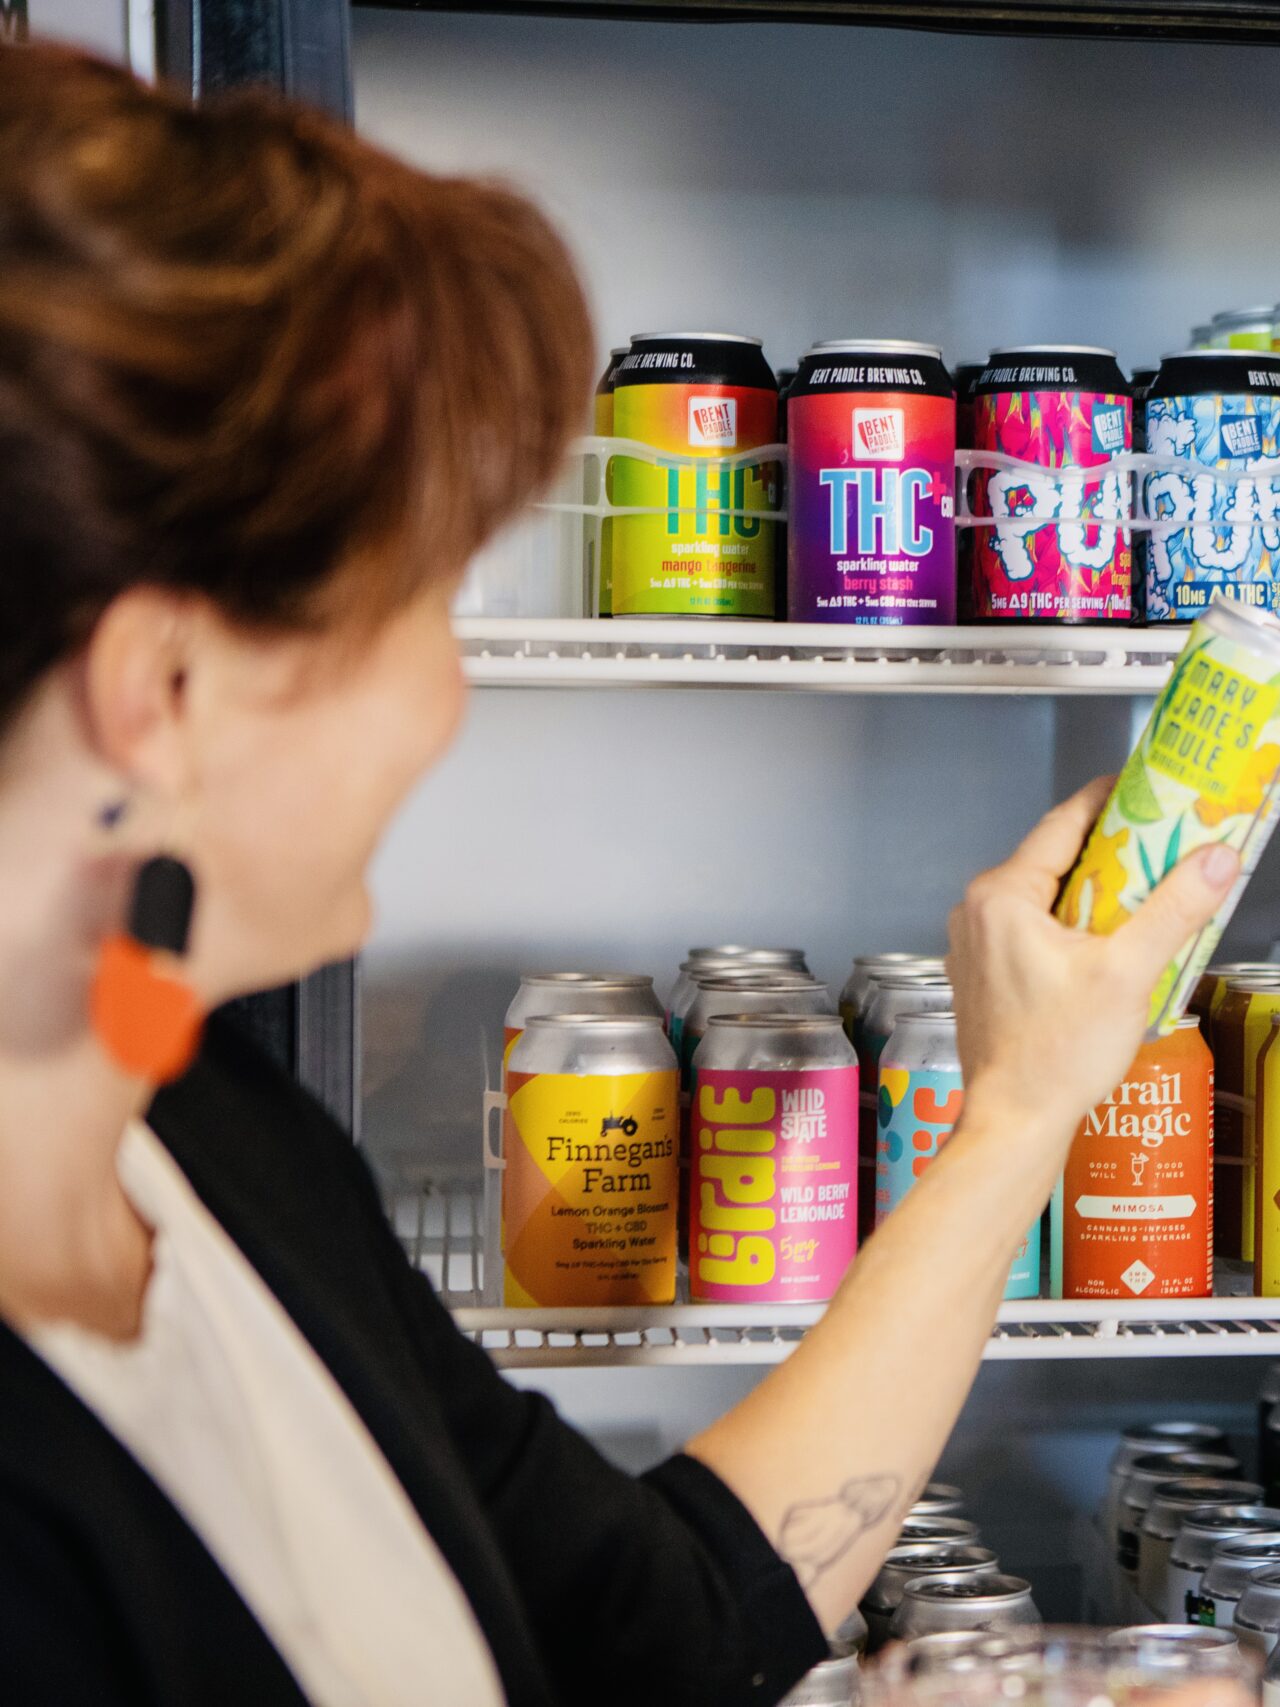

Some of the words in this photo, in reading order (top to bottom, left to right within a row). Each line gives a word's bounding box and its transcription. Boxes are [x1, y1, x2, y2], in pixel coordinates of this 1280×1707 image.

[680, 352, 696, 368] CO.
[809, 368, 831, 385] BENT
[831, 367, 865, 384] PADDLE
[867, 367, 910, 384] BREWING
[910, 369, 926, 386] CO.
[1019, 366, 1060, 382] BREWING
[1062, 367, 1078, 383] CO.
[1248, 371, 1269, 386] BENT
[701, 403, 729, 422] BENT
[1101, 410, 1122, 428] BENT
[703, 420, 732, 434] PADDLE
[865, 415, 895, 436] BENT
[1230, 418, 1256, 438] BENT
[869, 432, 897, 449] PADDLE
[1232, 436, 1260, 451] PADDLE
[655, 457, 761, 539] THC
[819, 467, 933, 557] THC
[672, 540, 720, 558] sparkling
[661, 560, 702, 575] mango
[837, 558, 887, 575] sparkling
[889, 560, 919, 572] water
[844, 576, 876, 593] berry
[879, 576, 913, 590] stash
[1030, 593, 1053, 609] THC
[1054, 597, 1070, 609] PER
[1072, 597, 1104, 610] SERVING
[1176, 584, 1205, 606] 10MG
[1239, 584, 1265, 606] THC
[1190, 660, 1257, 711] MARY
[1173, 691, 1253, 749] JANE'S
[1160, 720, 1222, 773] MULE
[781, 1088, 825, 1113] WILD
[780, 1115, 827, 1144] STATE
[1084, 1105, 1191, 1148] Magic
[547, 1134, 672, 1168] Finnegan's
[582, 1169, 651, 1192] Farm
[780, 1187, 814, 1204] WILD
[818, 1183, 850, 1201] BERRY
[551, 1206, 589, 1217] Lemon
[592, 1205, 634, 1218] Orange
[780, 1203, 845, 1223] LEMONADE
[1112, 1204, 1164, 1213] MIMOSA
[586, 1222, 612, 1234] THC
[624, 1220, 647, 1232] CBD
[1087, 1224, 1185, 1233] CANNABIS-INFUSED
[573, 1238, 626, 1251] Sparkling
[629, 1236, 656, 1248] Water
[1080, 1233, 1136, 1242] SPARKLING
[1142, 1233, 1191, 1242] BEVERAGE
[1075, 1286, 1119, 1295] ALCOHOLIC
